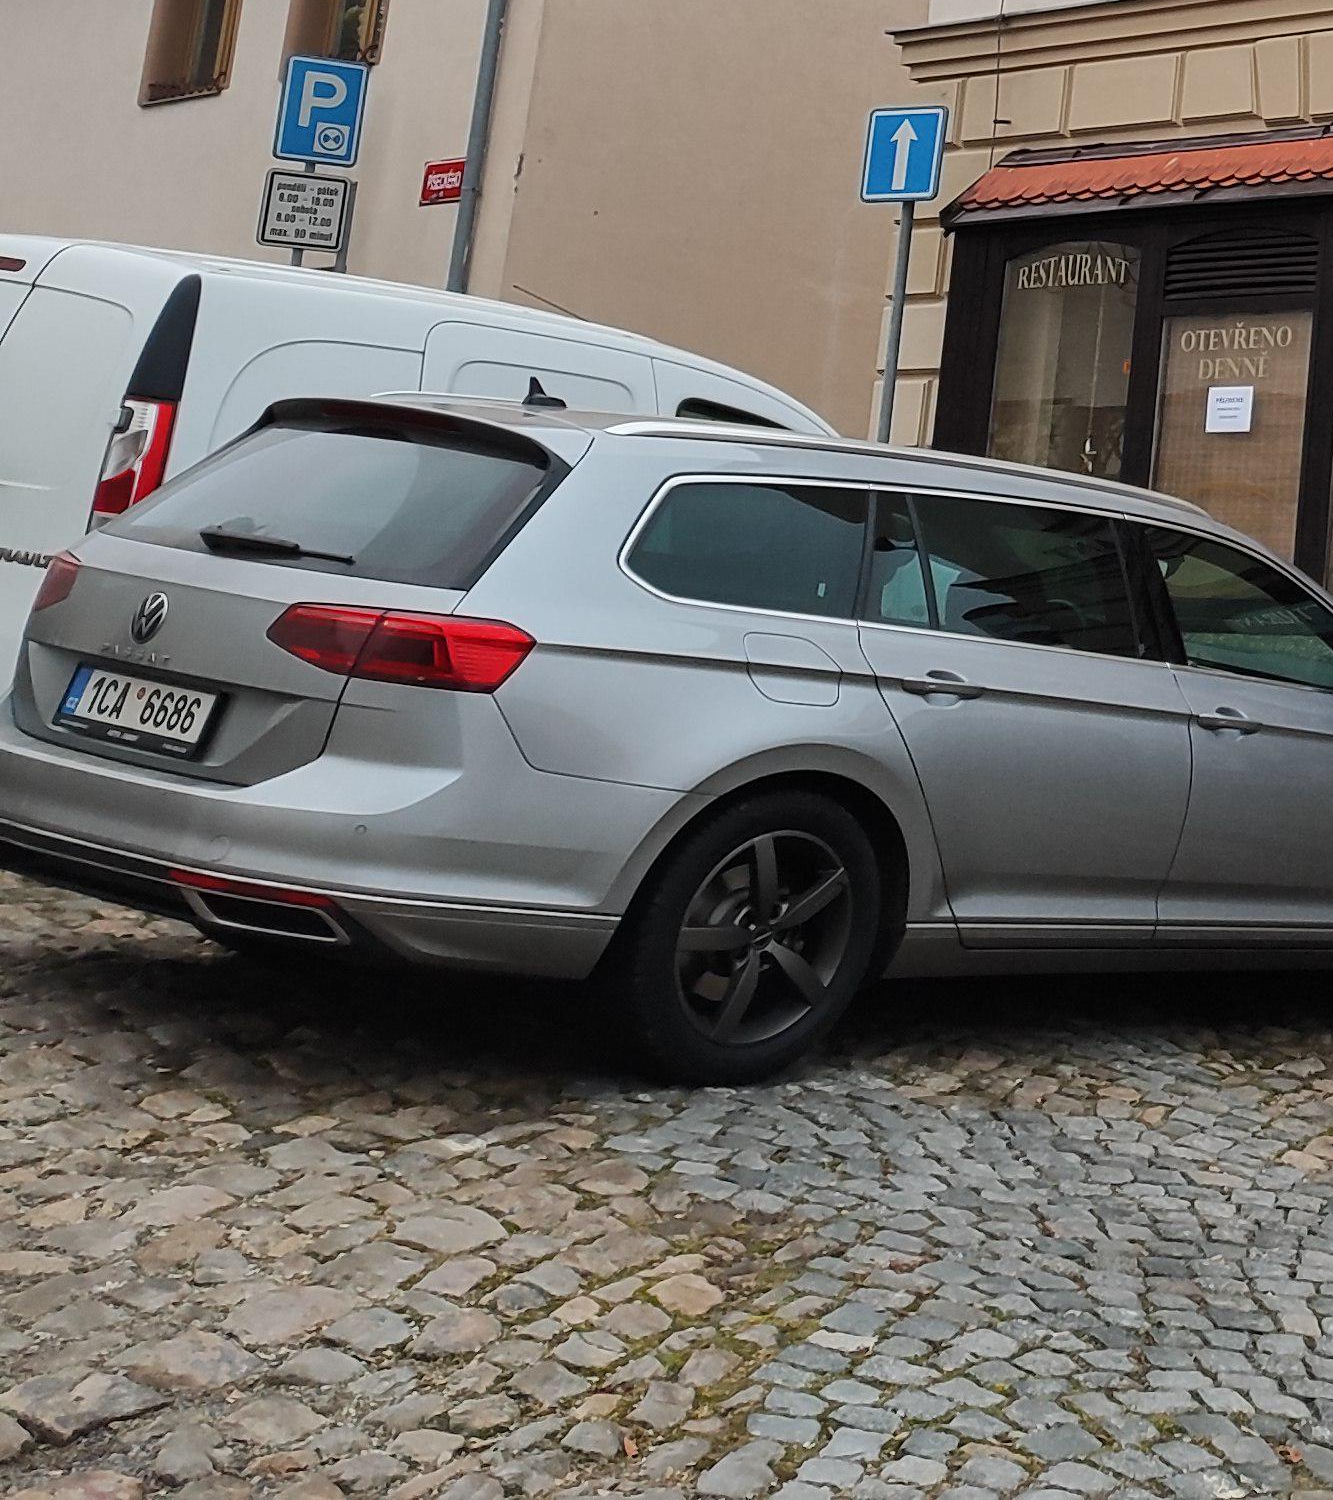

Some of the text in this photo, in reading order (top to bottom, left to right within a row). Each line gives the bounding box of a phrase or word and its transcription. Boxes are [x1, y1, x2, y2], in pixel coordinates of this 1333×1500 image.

[297, 70, 348, 128] P
[1016, 252, 1130, 291] RESTAURANT
[1179, 321, 1293, 354] OTEVŘENO
[1198, 351, 1271, 380] DENNĚ
[87, 675, 202, 735] 1CA 6686
